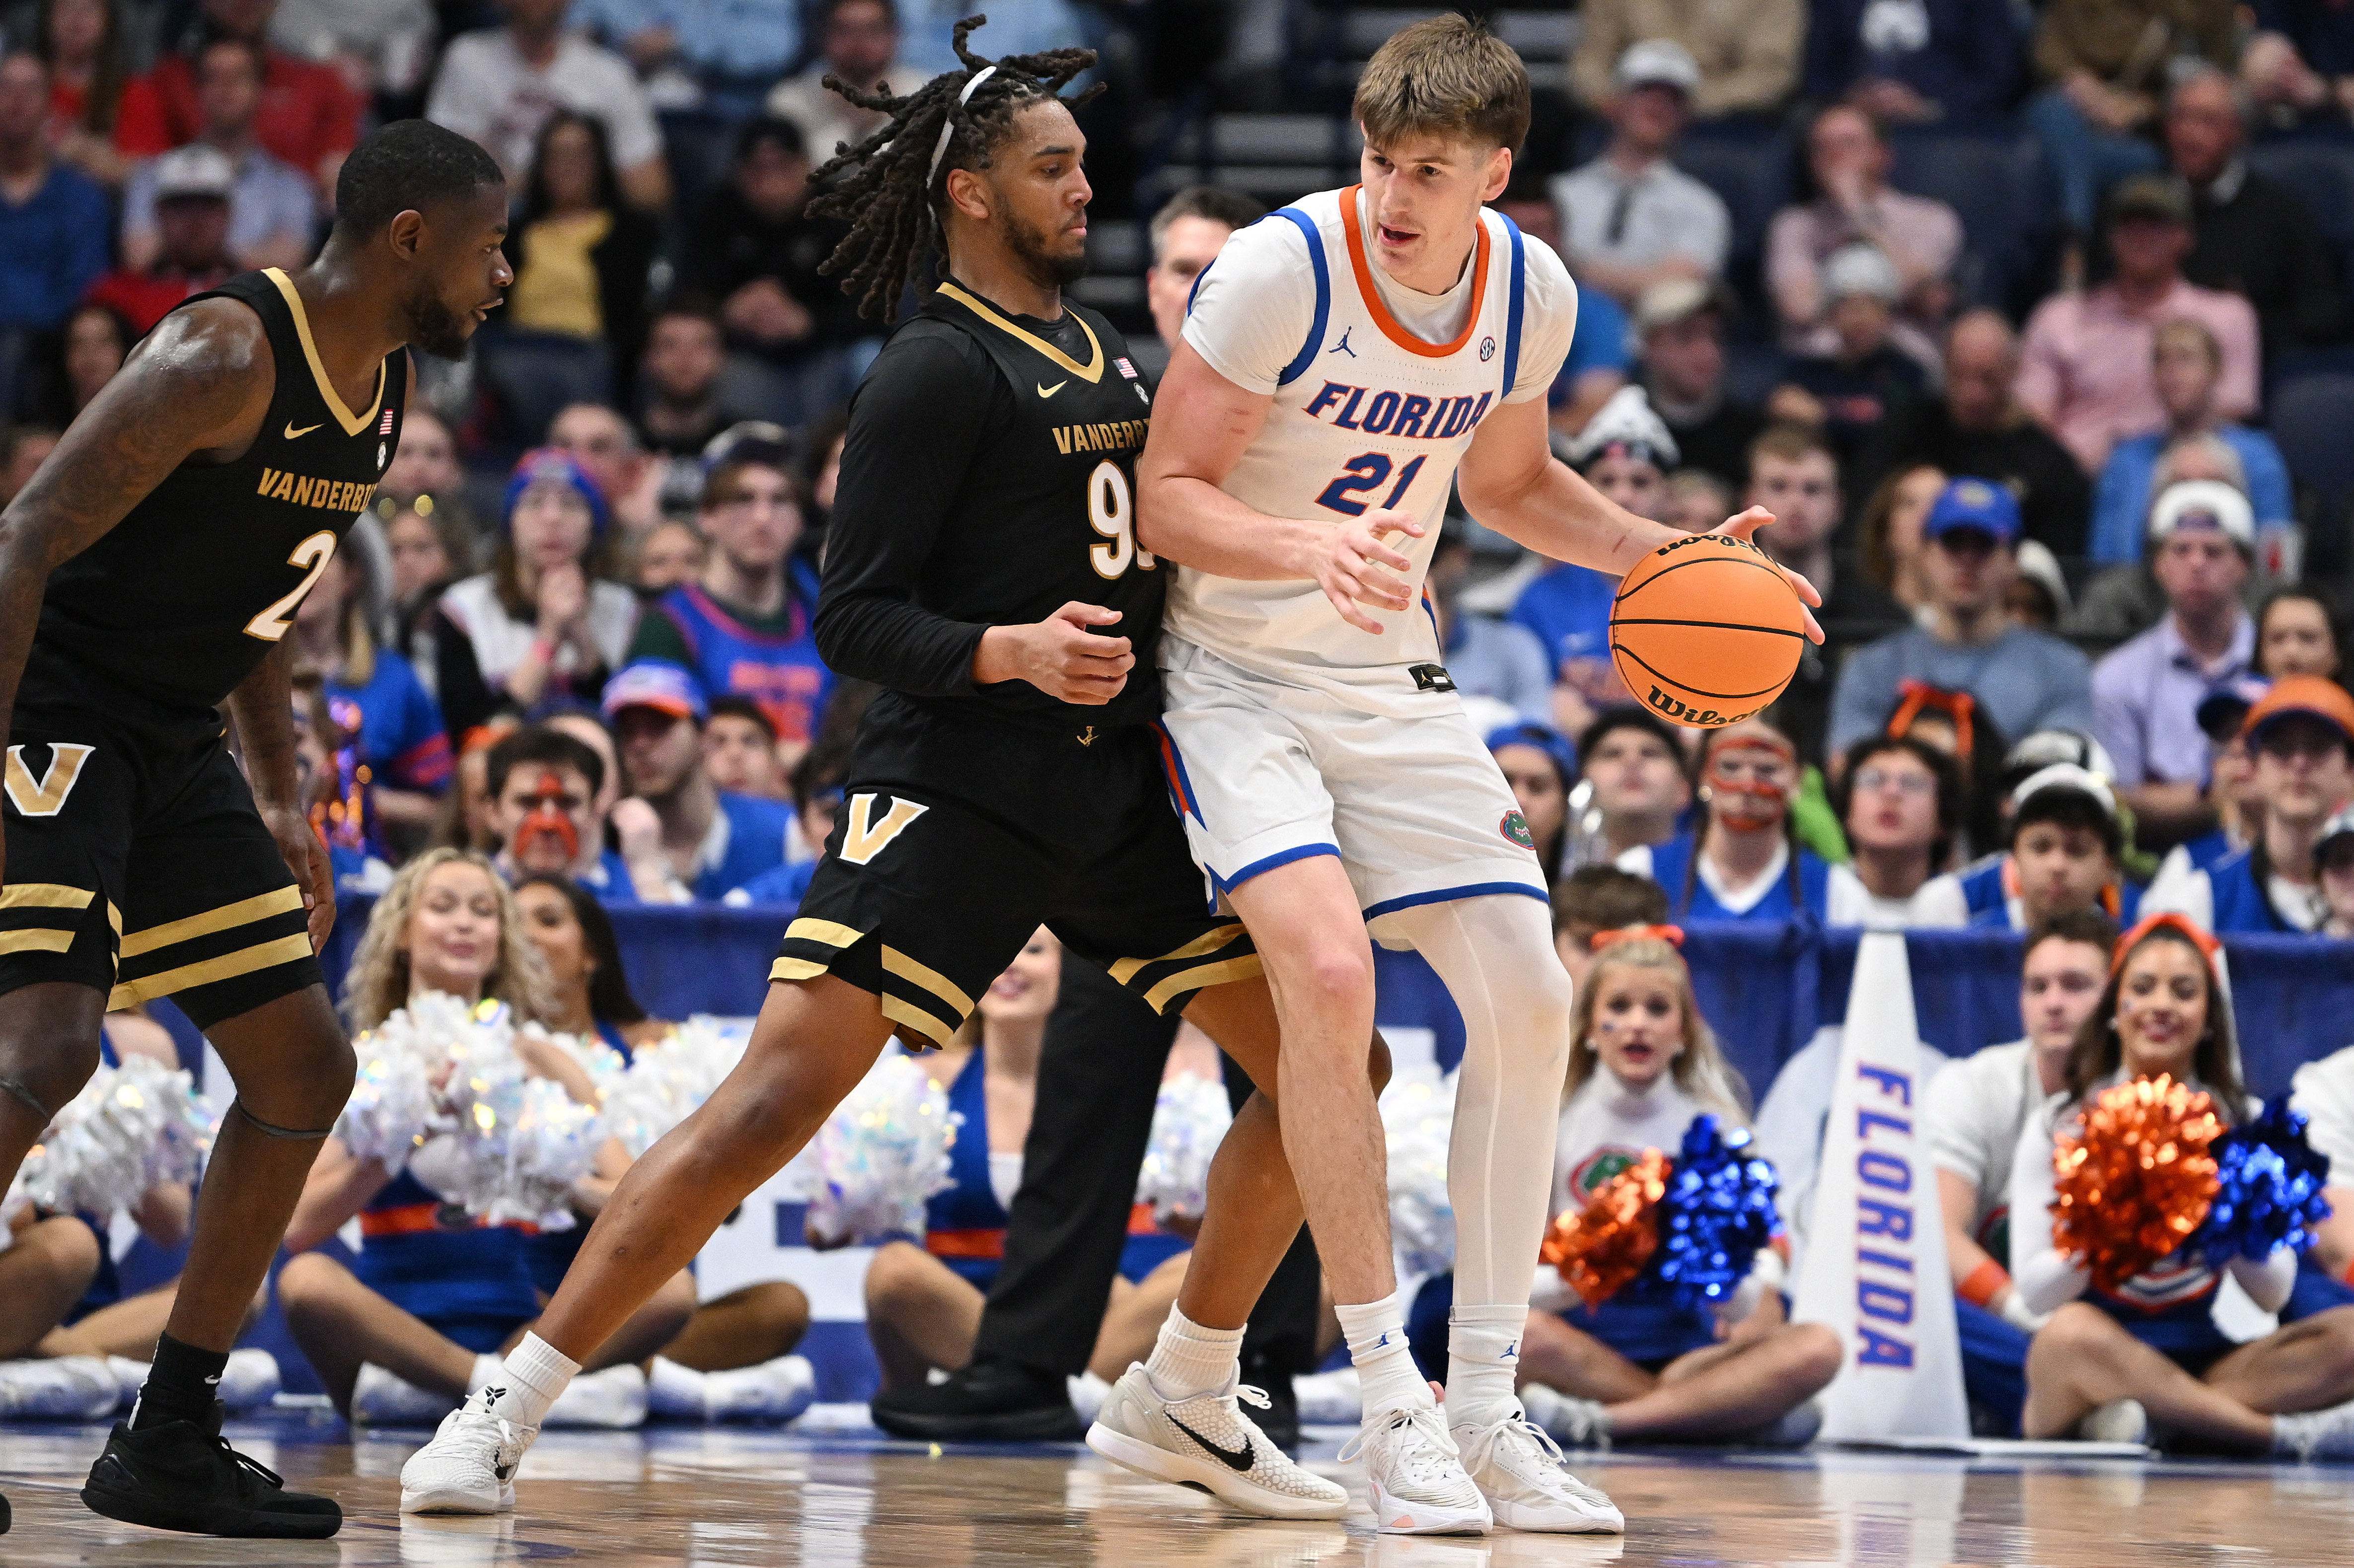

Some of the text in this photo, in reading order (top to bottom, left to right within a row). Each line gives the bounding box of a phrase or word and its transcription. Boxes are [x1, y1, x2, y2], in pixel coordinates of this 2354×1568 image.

[1480, 338, 1495, 360] SEC
[1052, 418, 1150, 454] VANDERB
[1301, 379, 1494, 439] FLORIDA
[1087, 452, 1157, 580] 9
[1314, 451, 1429, 517] 21
[242, 529, 337, 641] 2
[3, 742, 96, 816] V
[838, 793, 930, 865] V
[1855, 1061, 1916, 1369] FLORIDA
